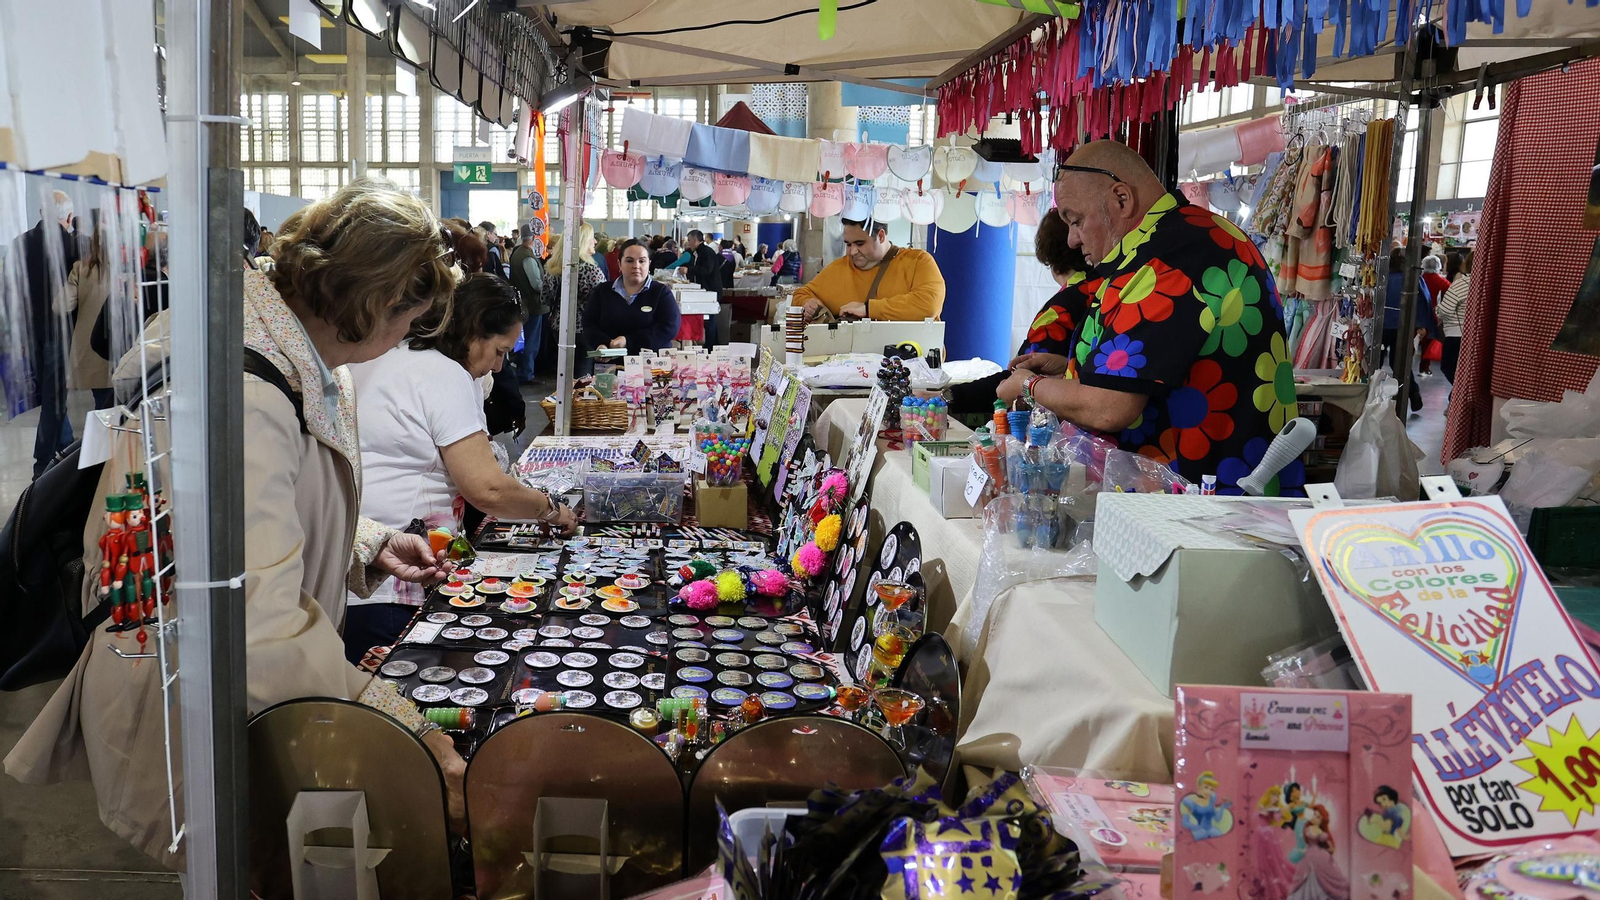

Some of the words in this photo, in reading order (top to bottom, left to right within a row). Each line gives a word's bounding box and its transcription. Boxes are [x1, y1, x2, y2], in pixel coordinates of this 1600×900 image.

[1354, 534, 1496, 570] Anillo
[1368, 573, 1498, 592] Colores
[1391, 567, 1429, 578] con
[1433, 564, 1466, 574] los
[1417, 588, 1444, 601] de
[1447, 586, 1468, 599] la
[1367, 584, 1515, 648] Felicidad
[1412, 654, 1600, 782] LLÉVATELO
[1444, 783, 1480, 814] por
[1479, 776, 1520, 802] tan
[1460, 802, 1535, 835] SOLO
